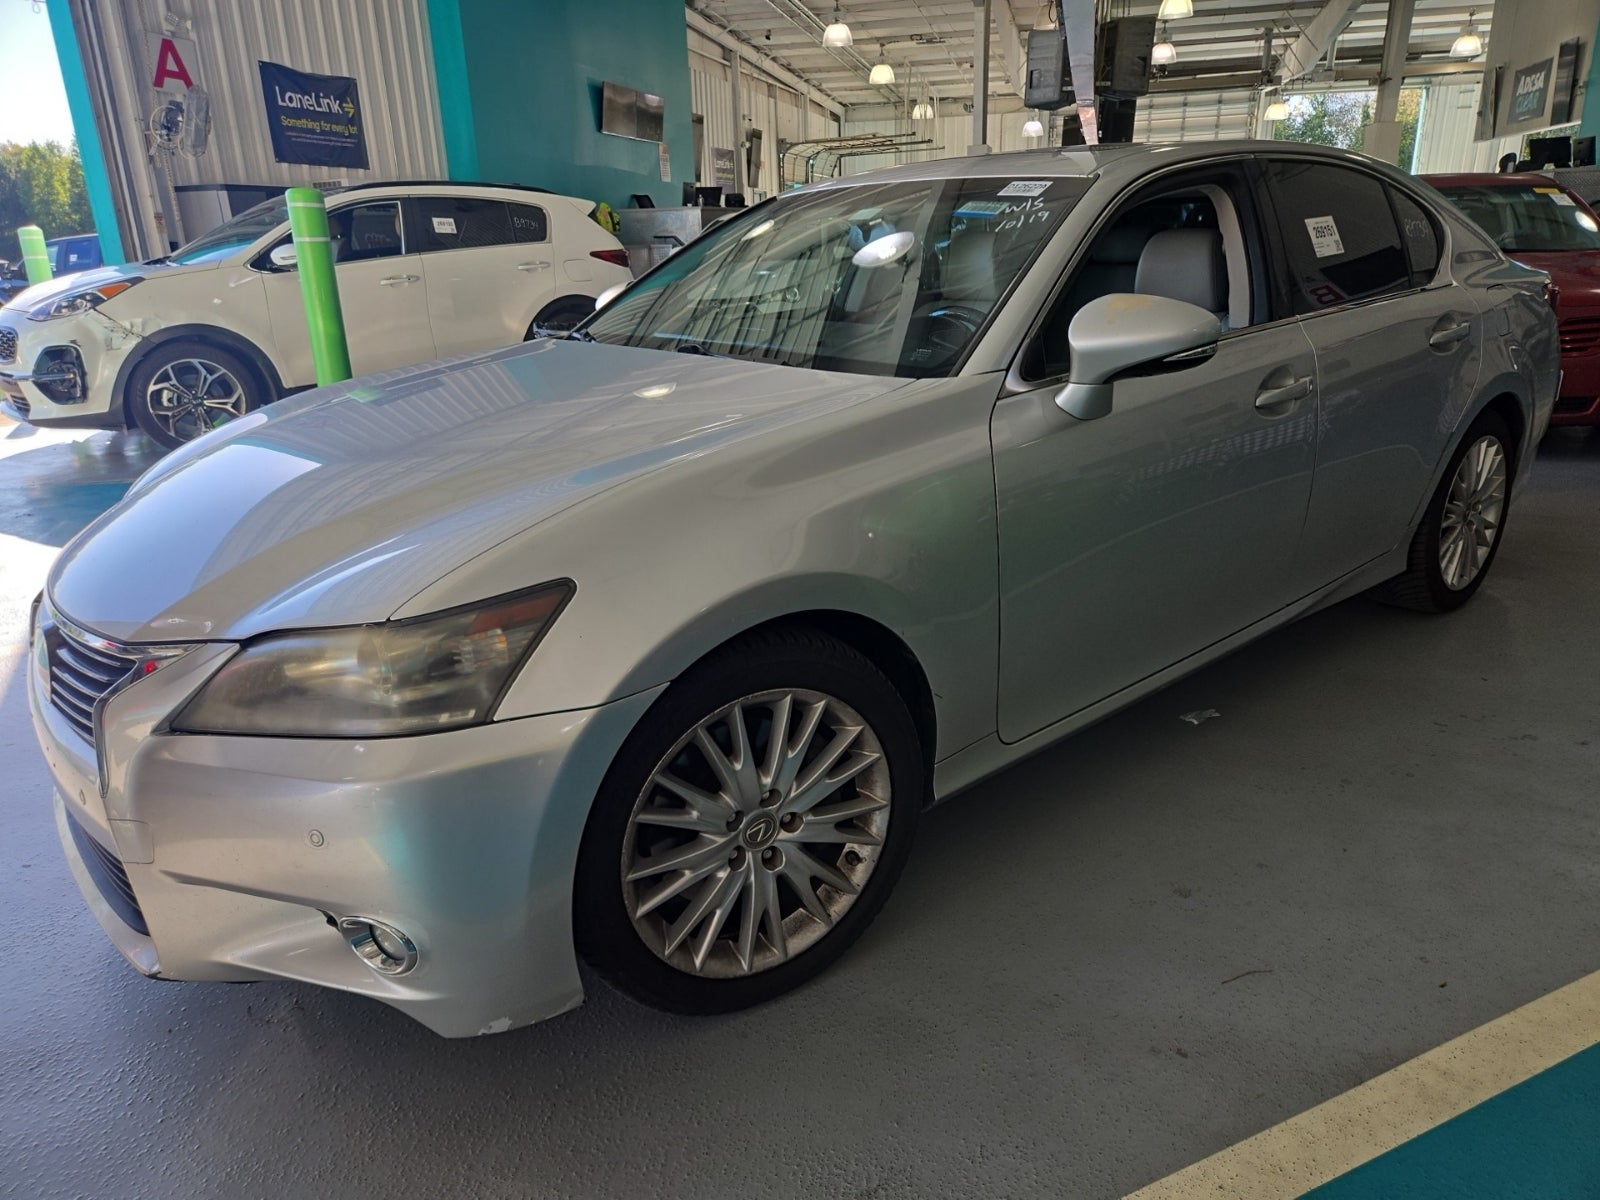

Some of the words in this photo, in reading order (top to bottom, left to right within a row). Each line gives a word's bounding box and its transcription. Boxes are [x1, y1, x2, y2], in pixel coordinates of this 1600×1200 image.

[153, 38, 194, 89] A
[1516, 71, 1545, 96] ADESA
[275, 86, 343, 115] LaneLink
[281, 115, 320, 132] Something
[321, 120, 331, 131] for
[331, 123, 348, 136] every
[1313, 224, 1336, 239] 269151
